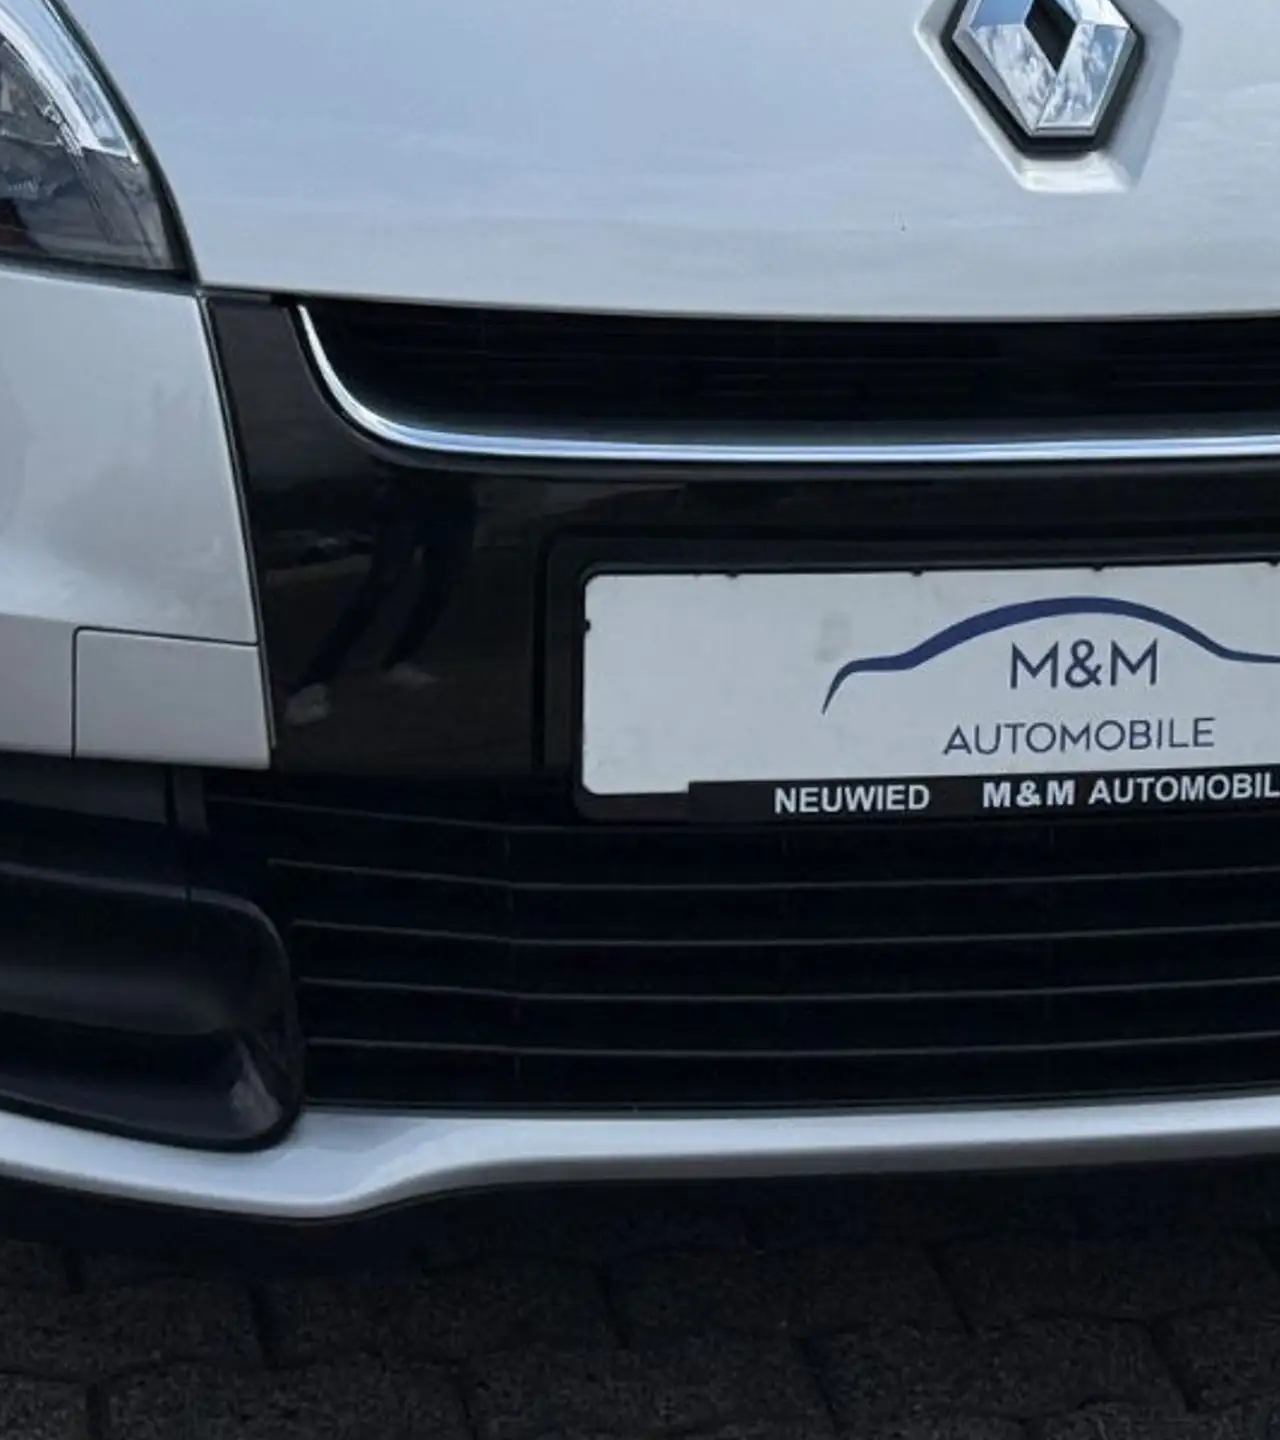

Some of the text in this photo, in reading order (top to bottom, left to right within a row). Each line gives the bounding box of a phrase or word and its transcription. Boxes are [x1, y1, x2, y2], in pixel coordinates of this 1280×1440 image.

[1010, 637, 1158, 689] M&M
[942, 717, 1216, 756] AUTOMOBILE
[773, 784, 931, 815] NEUWIED
[982, 779, 1075, 809] M&M
